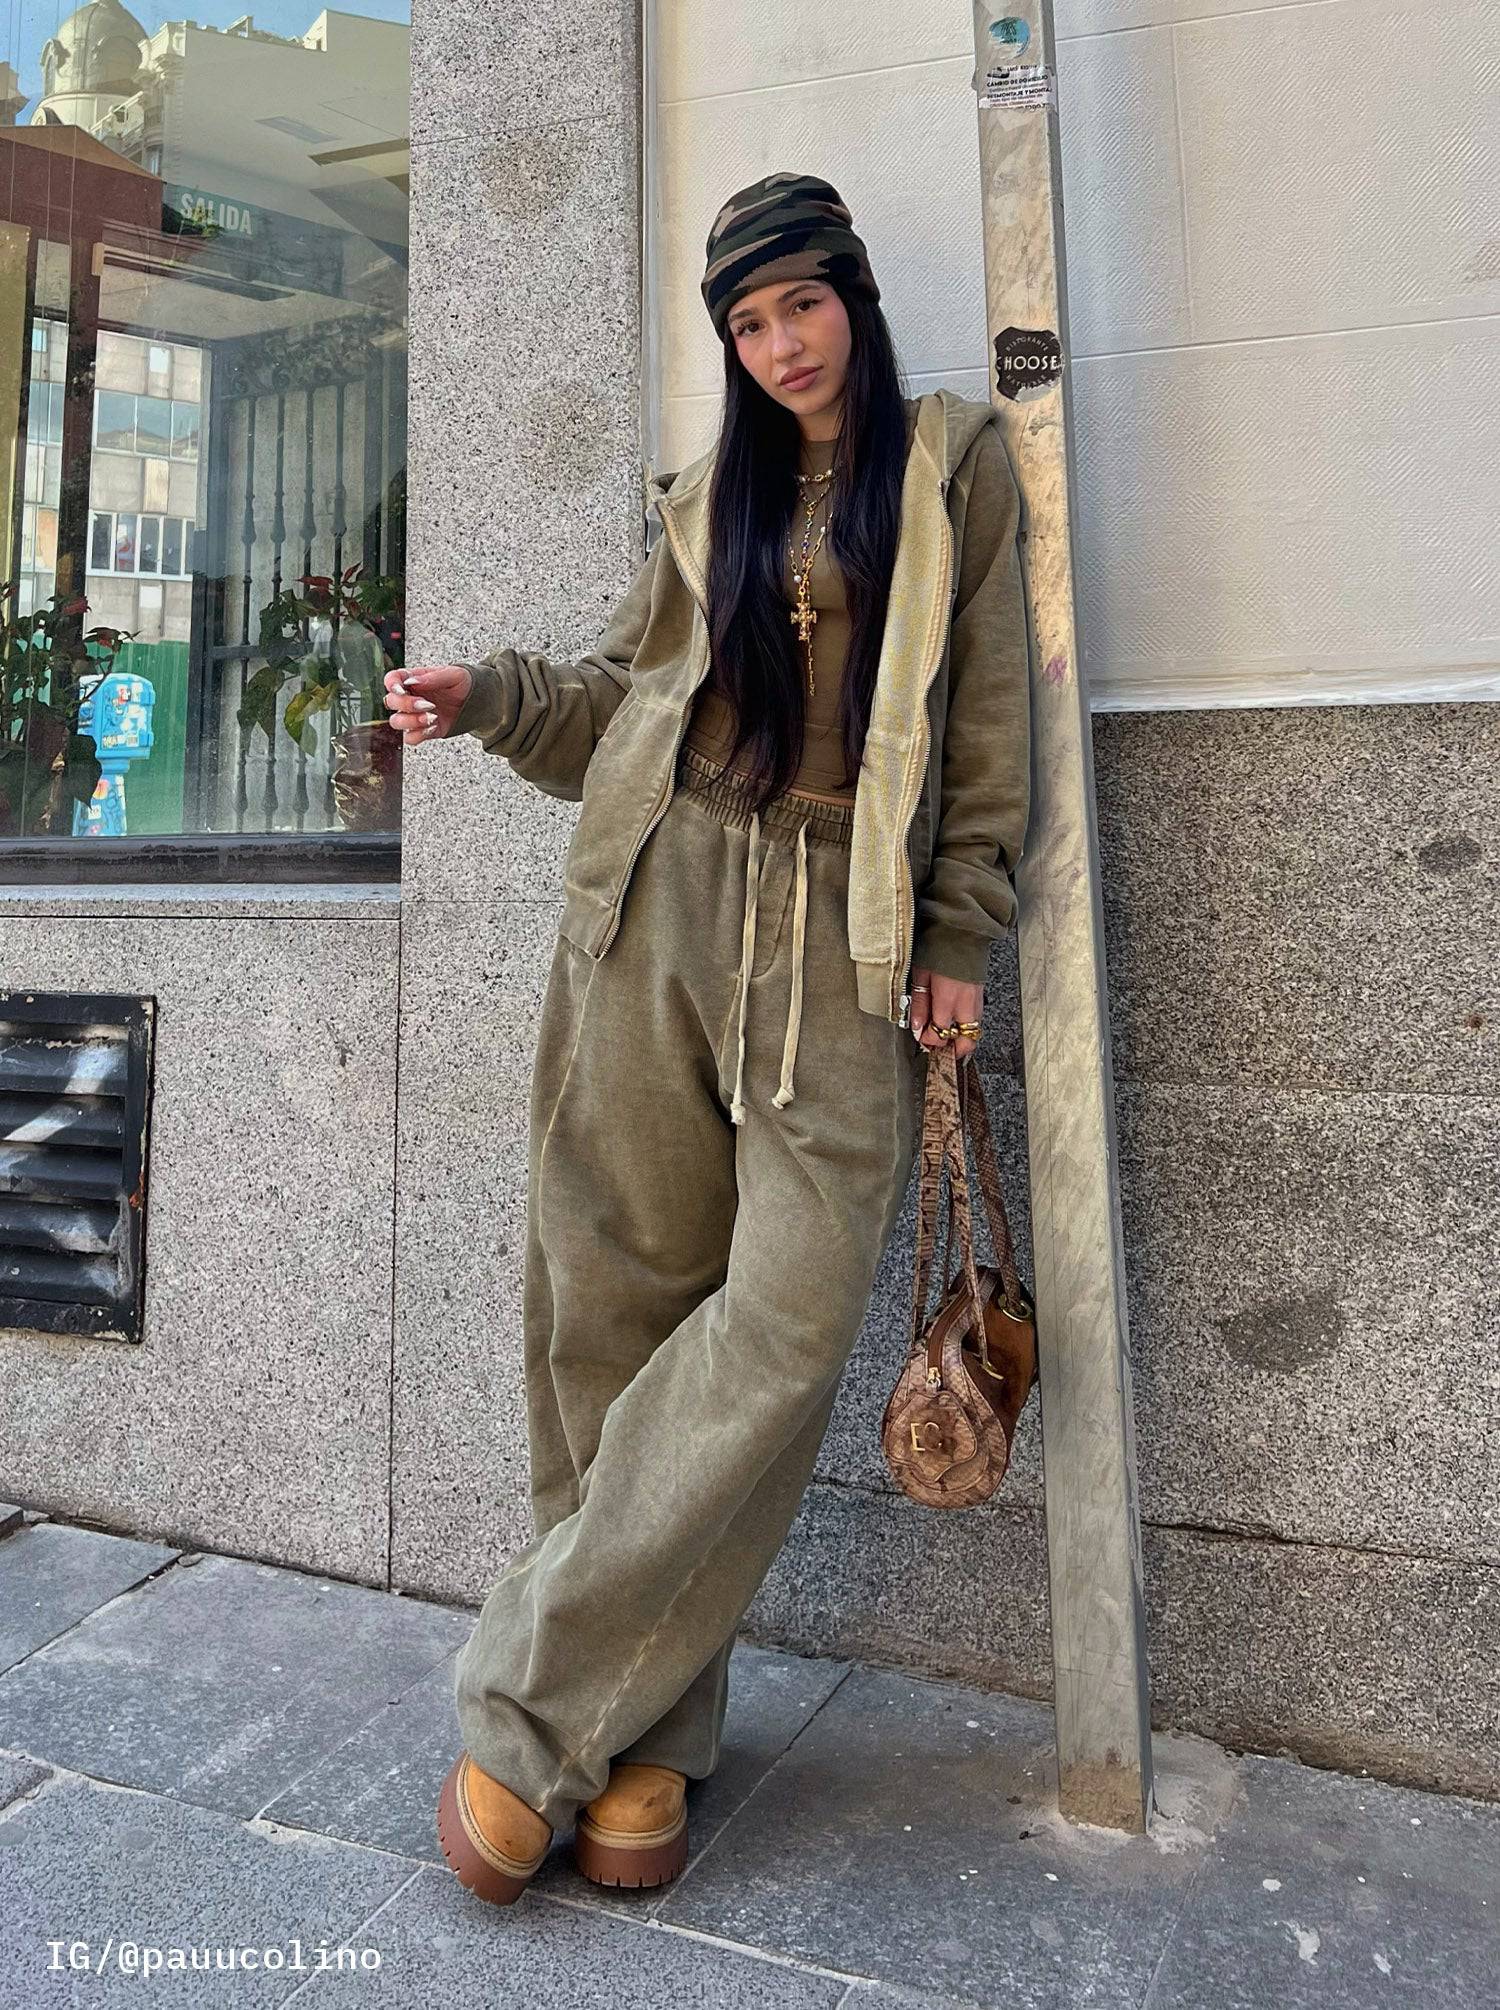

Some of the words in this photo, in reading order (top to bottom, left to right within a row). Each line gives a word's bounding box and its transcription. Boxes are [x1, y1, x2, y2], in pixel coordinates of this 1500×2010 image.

[987, 80, 1009, 88] CAMBIO
[987, 90, 1023, 99] DESMONTAJE
[181, 193, 252, 235] SALIDA
